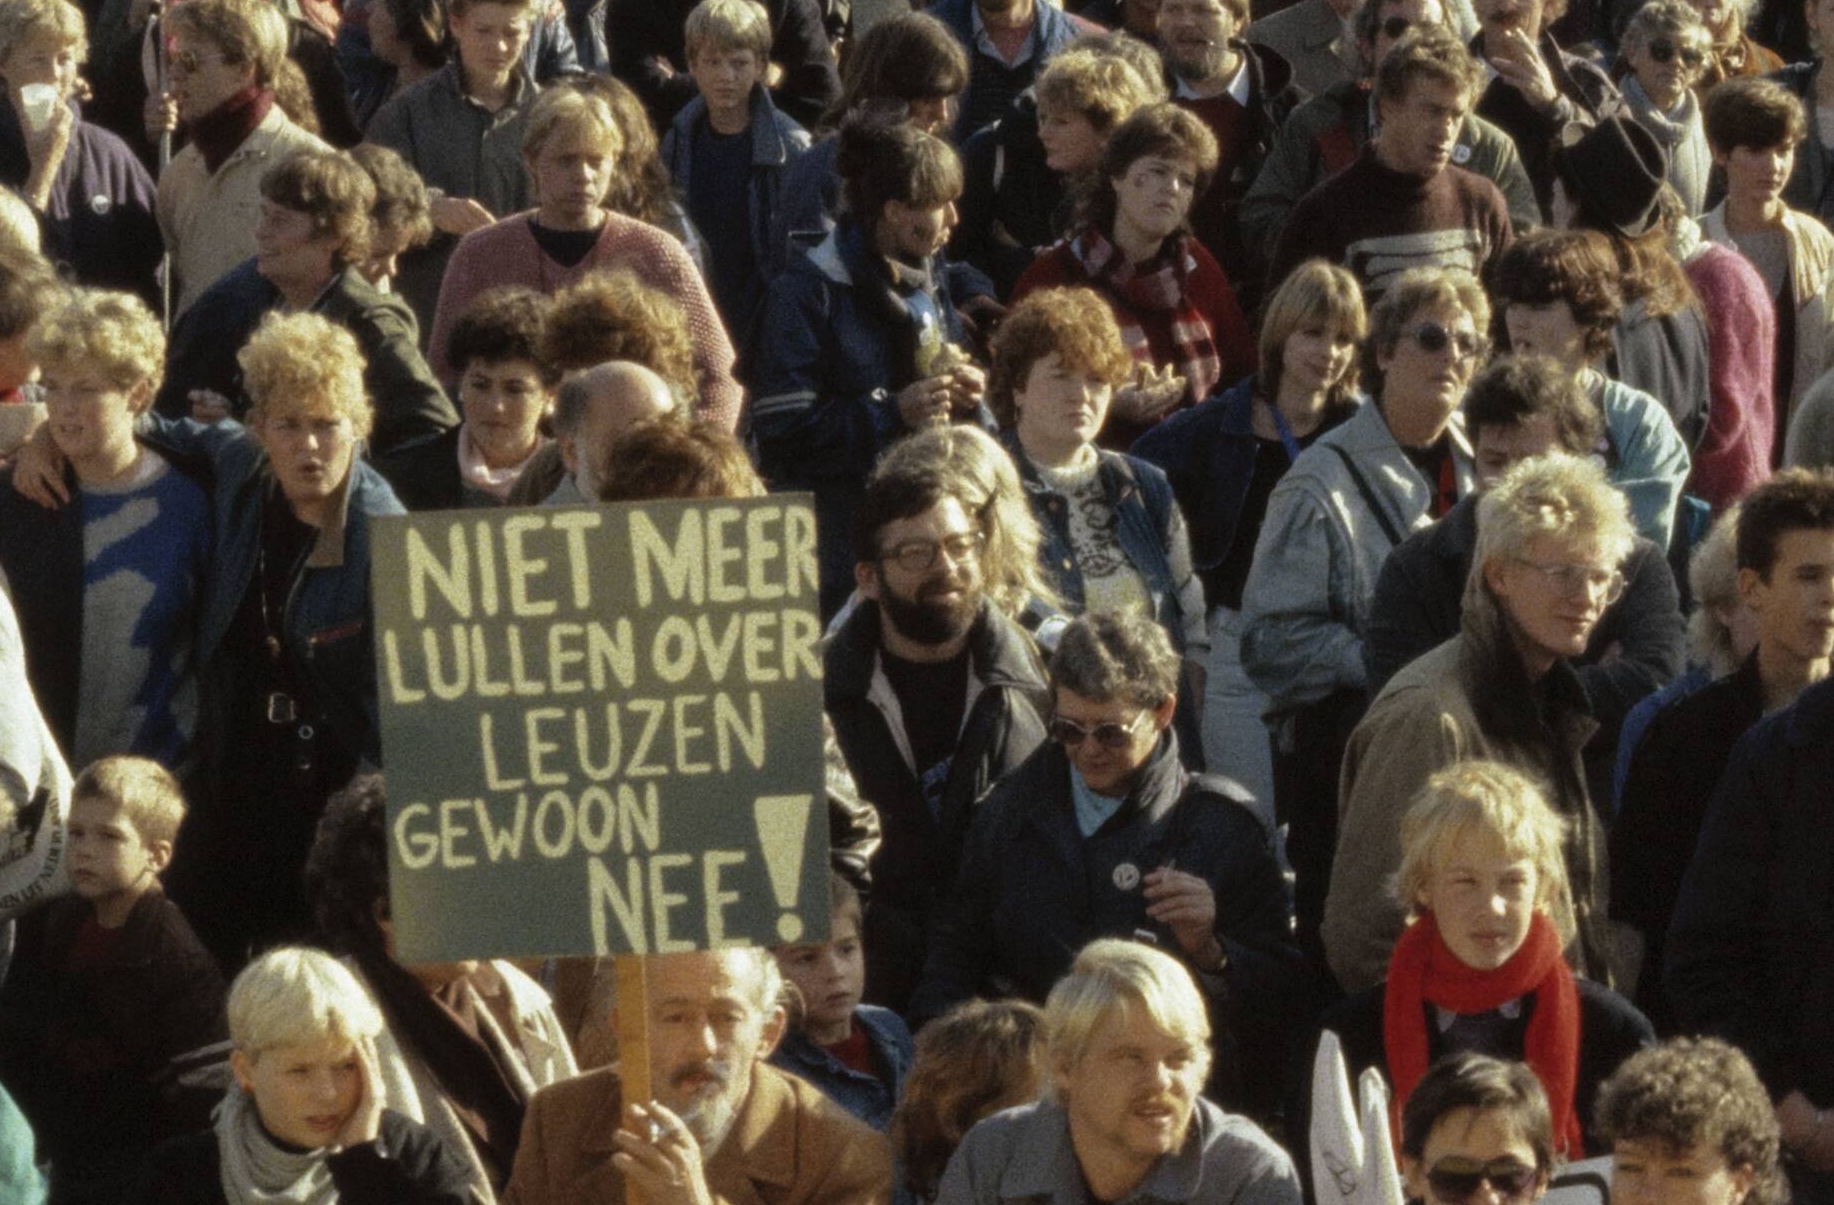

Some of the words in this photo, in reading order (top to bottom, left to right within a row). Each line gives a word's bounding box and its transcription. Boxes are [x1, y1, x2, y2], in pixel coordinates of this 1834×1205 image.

[406, 511, 601, 619] NIET
[628, 506, 820, 608] MEER
[384, 617, 636, 703] LULLEN
[651, 608, 823, 683] OVER
[480, 692, 765, 791] LEUZEN
[393, 782, 660, 870] GEWOON
